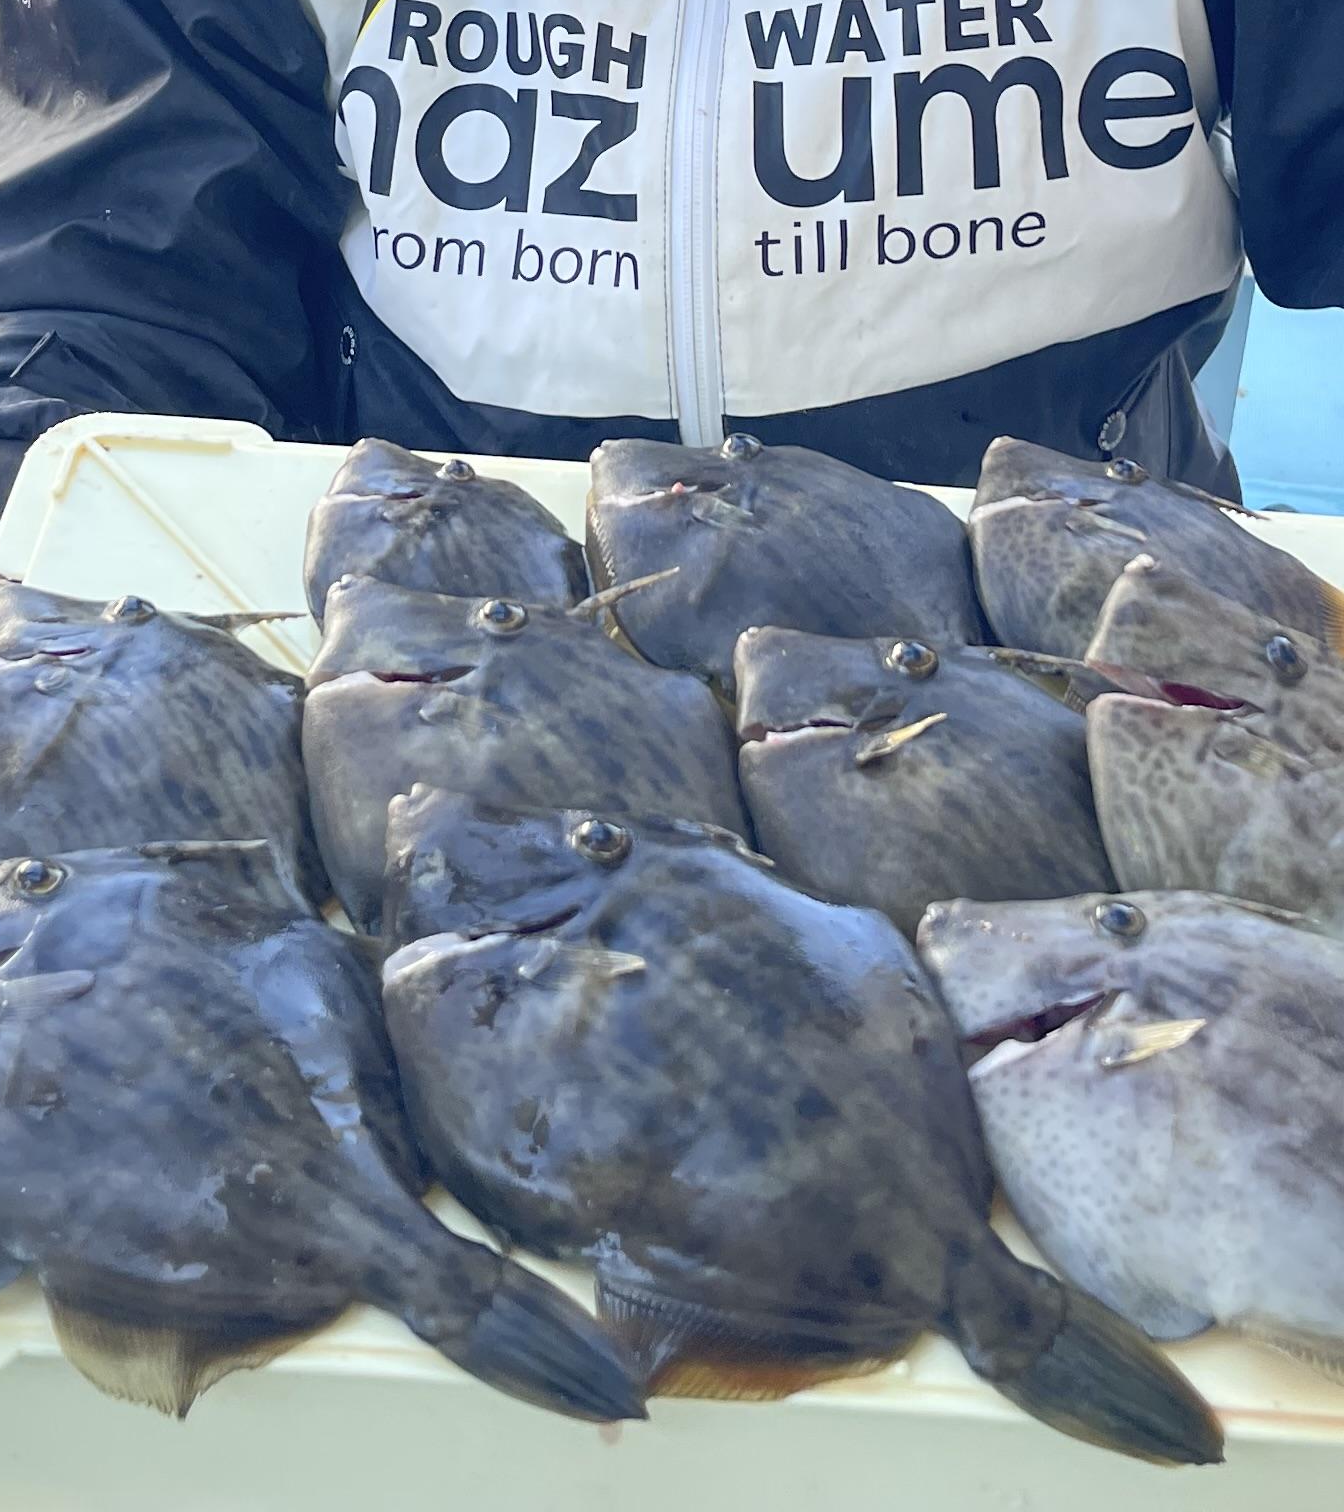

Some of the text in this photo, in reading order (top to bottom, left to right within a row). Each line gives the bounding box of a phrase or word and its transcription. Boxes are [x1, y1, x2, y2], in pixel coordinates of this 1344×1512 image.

[752, 47, 1194, 208] ume
[373, 211, 1046, 290] rom born till bone
